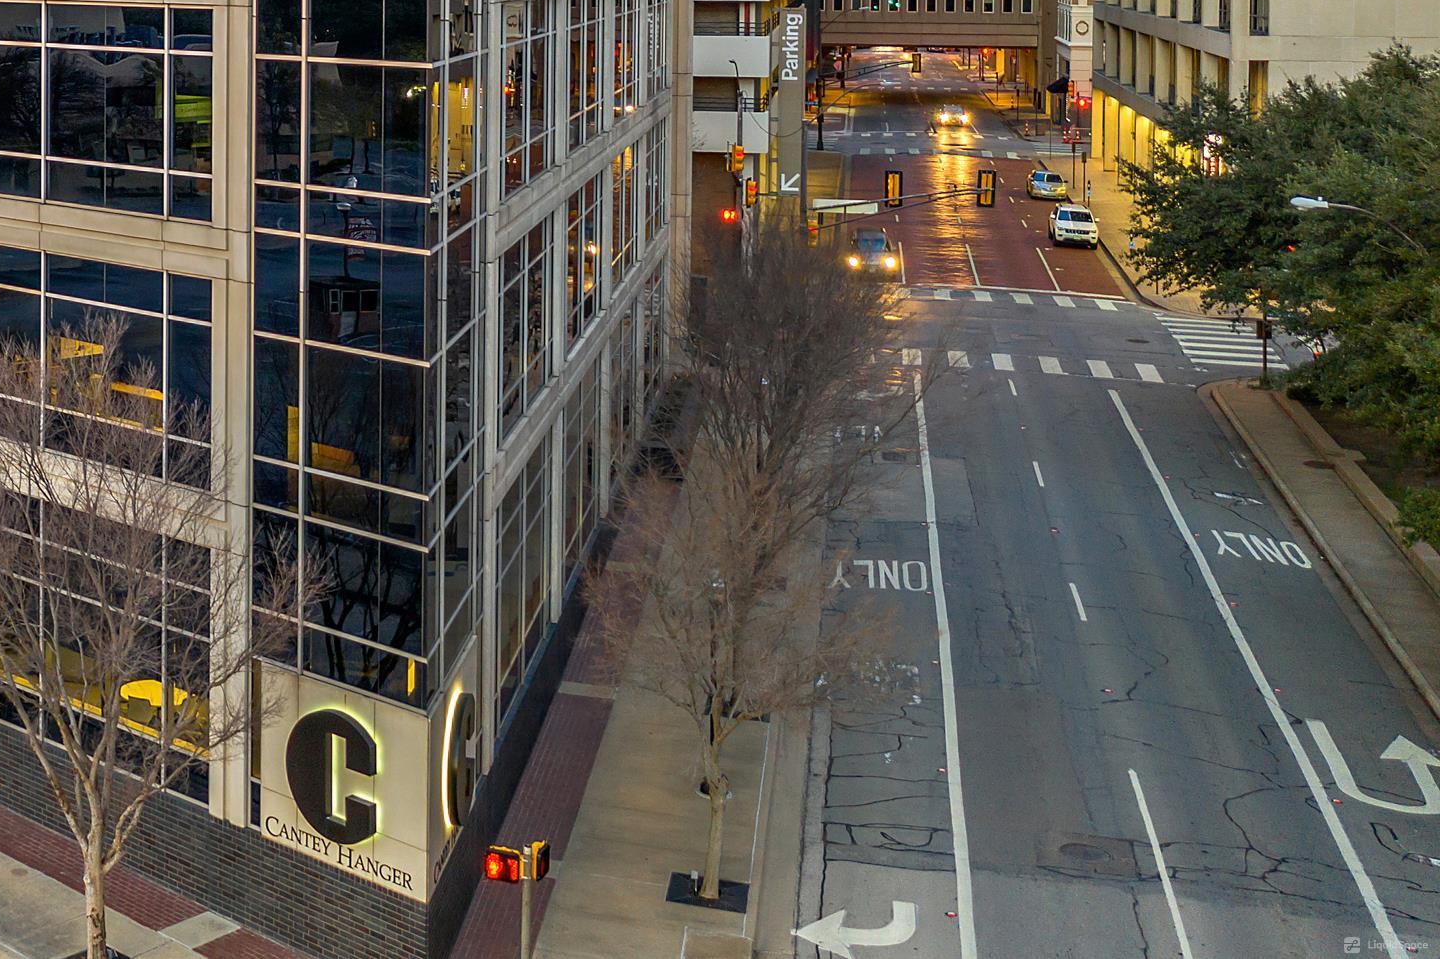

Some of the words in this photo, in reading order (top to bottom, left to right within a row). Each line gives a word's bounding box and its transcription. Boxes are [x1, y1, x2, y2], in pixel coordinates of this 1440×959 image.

[782, 13, 803, 81] Parking
[827, 559, 928, 592] ONLY
[1211, 529, 1312, 569] ONLY
[265, 816, 331, 856] CANTEY
[337, 843, 413, 890] HANGER
